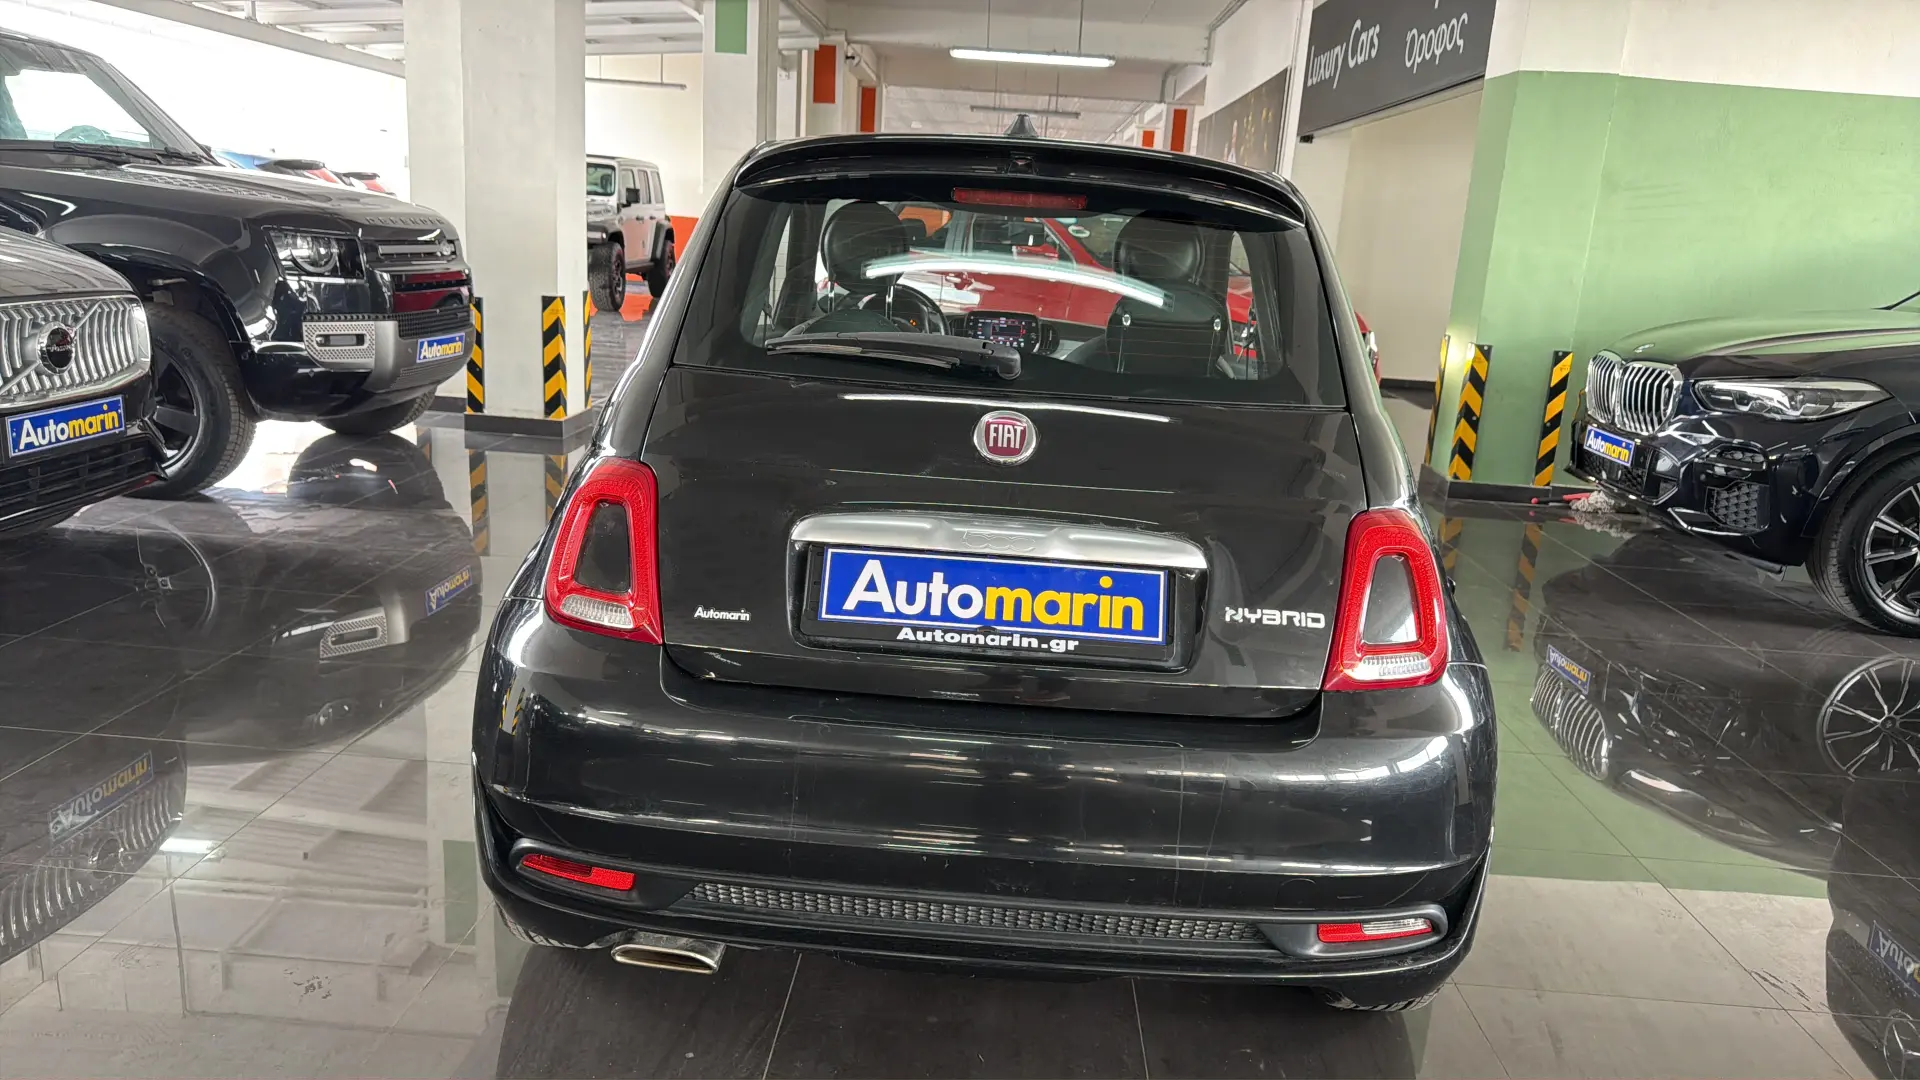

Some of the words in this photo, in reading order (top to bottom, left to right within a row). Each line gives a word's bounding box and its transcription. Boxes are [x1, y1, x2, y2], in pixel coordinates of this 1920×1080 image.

[1307, 42, 1346, 89] Luxury
[1348, 19, 1380, 69] Cars
[420, 336, 462, 359] Automarin
[19, 404, 119, 449] Automarin
[988, 423, 1024, 449] FIAT
[1586, 430, 1629, 462] Automarin
[842, 559, 1144, 630] Automarin
[693, 605, 750, 621] Automarin
[1225, 606, 1325, 629] HYBRID
[896, 627, 1079, 652] Automarin.gr
